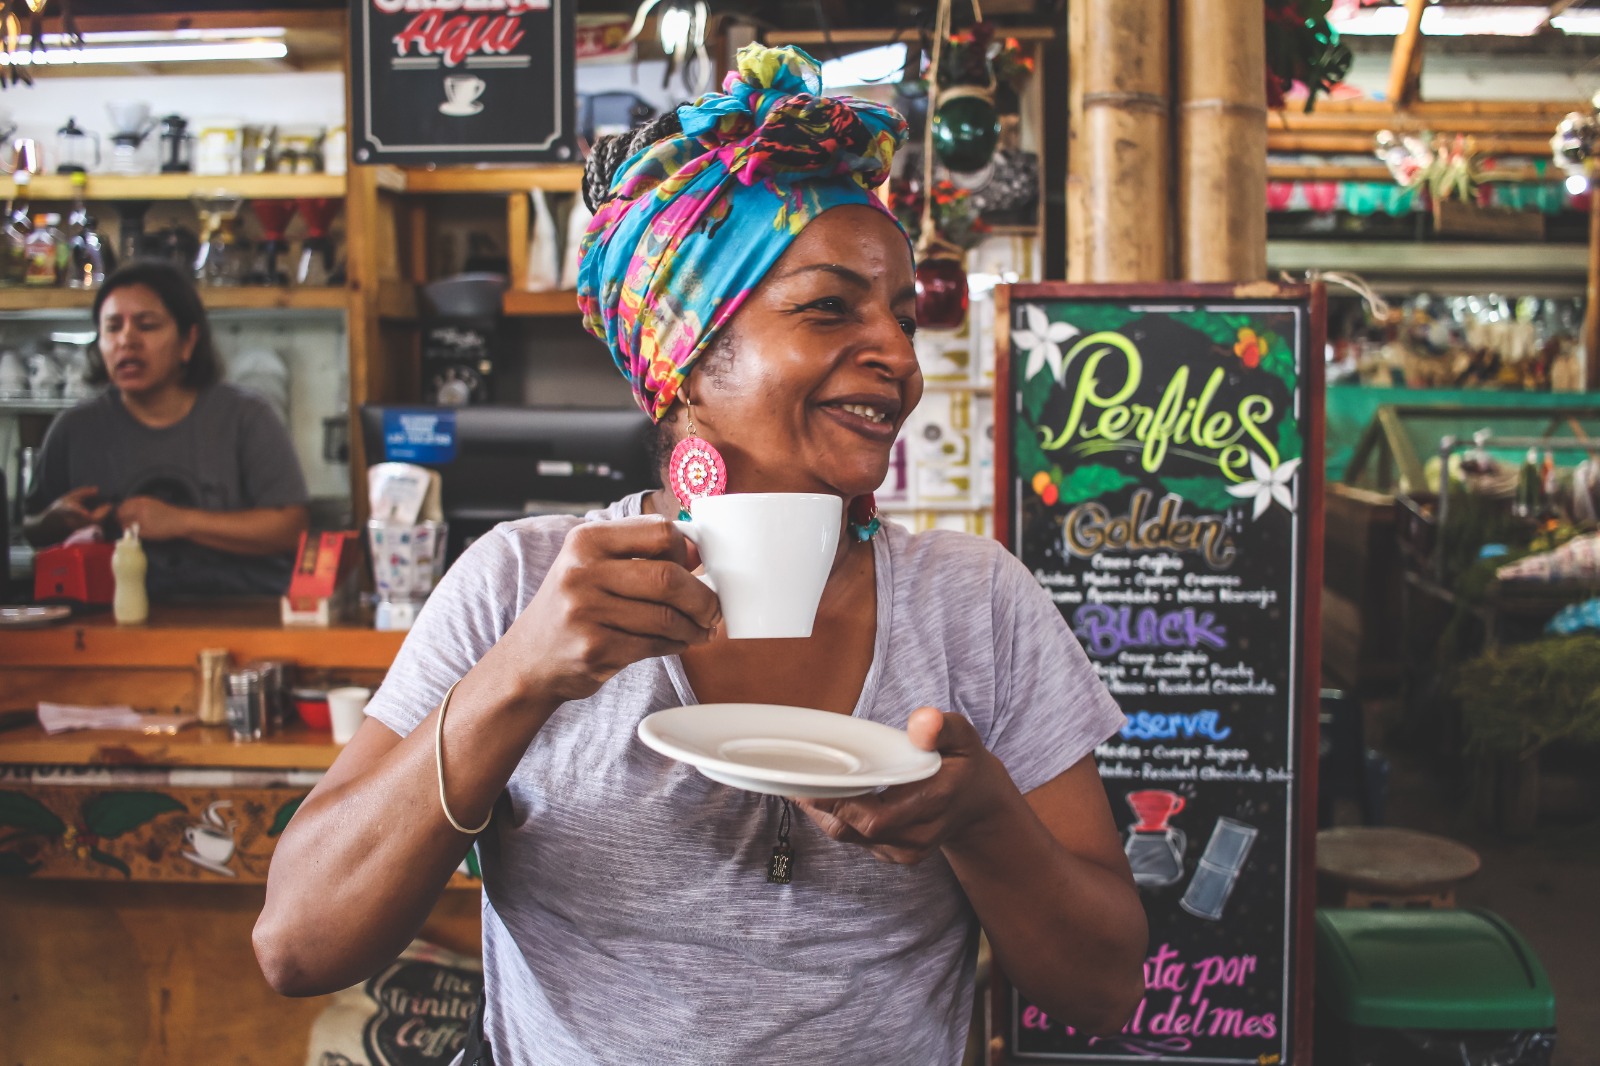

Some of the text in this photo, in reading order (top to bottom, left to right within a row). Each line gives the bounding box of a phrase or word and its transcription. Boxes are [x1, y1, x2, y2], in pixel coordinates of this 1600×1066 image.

[1063, 490, 1235, 568] Golden
[1119, 709, 1232, 741] eserva
[1192, 954, 1258, 1006] por
[1149, 994, 1208, 1036] del
[1208, 1006, 1278, 1039] mes
